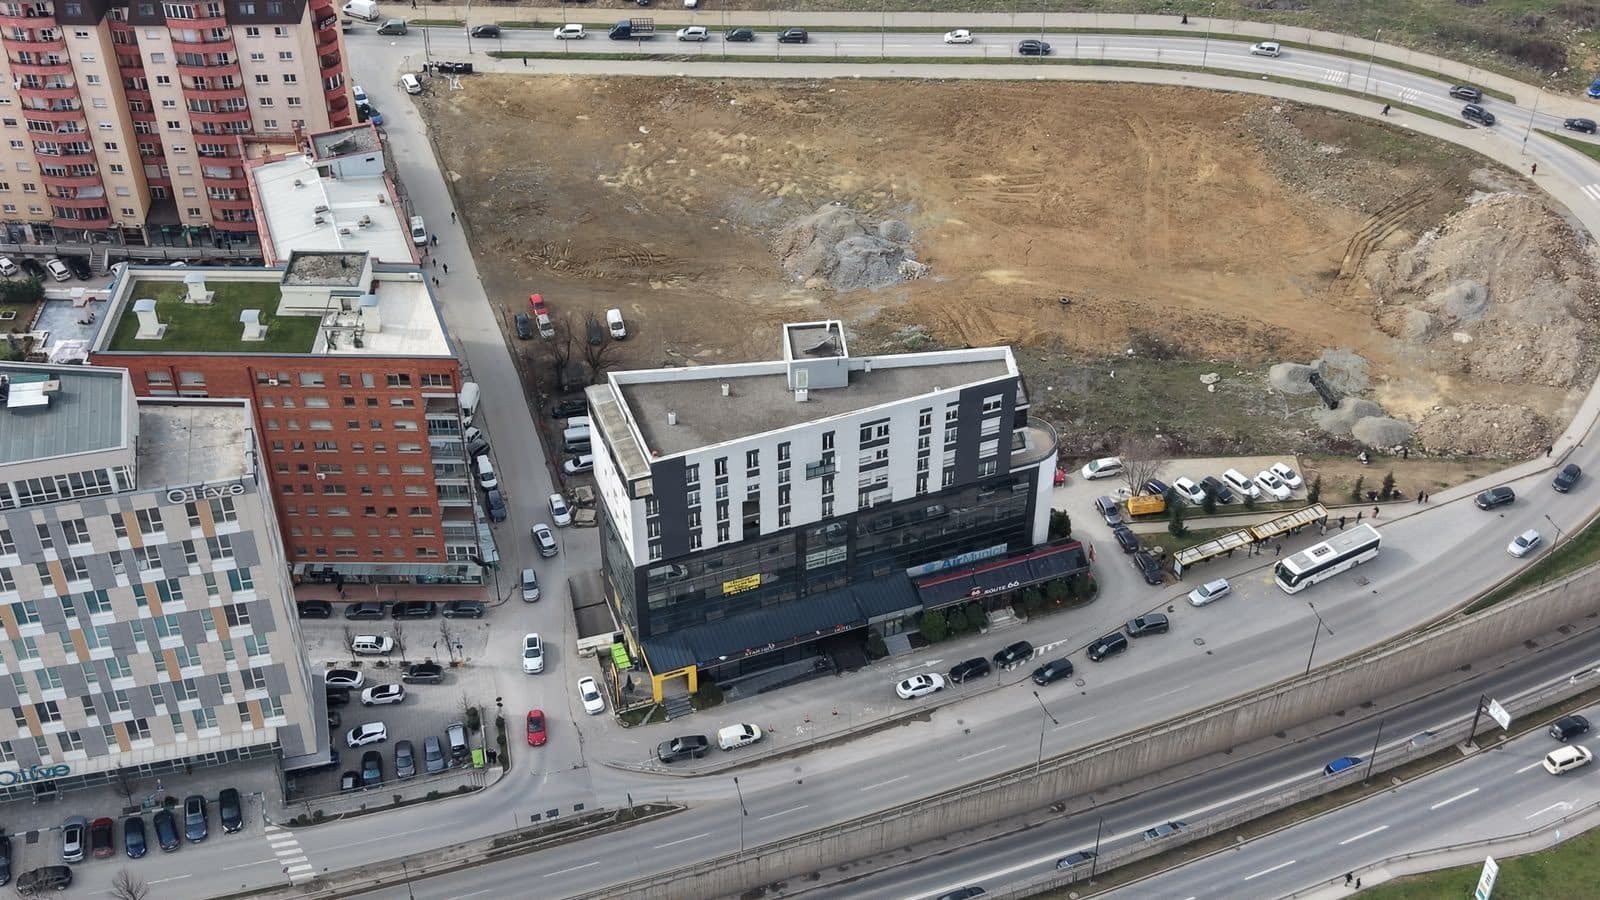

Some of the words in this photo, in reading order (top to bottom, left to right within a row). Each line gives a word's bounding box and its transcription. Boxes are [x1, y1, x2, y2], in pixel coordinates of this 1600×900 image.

[167, 484, 245, 504] Olive
[984, 586, 1006, 595] ROUTE
[1007, 580, 1020, 588] 66
[0, 763, 70, 786] Olive
